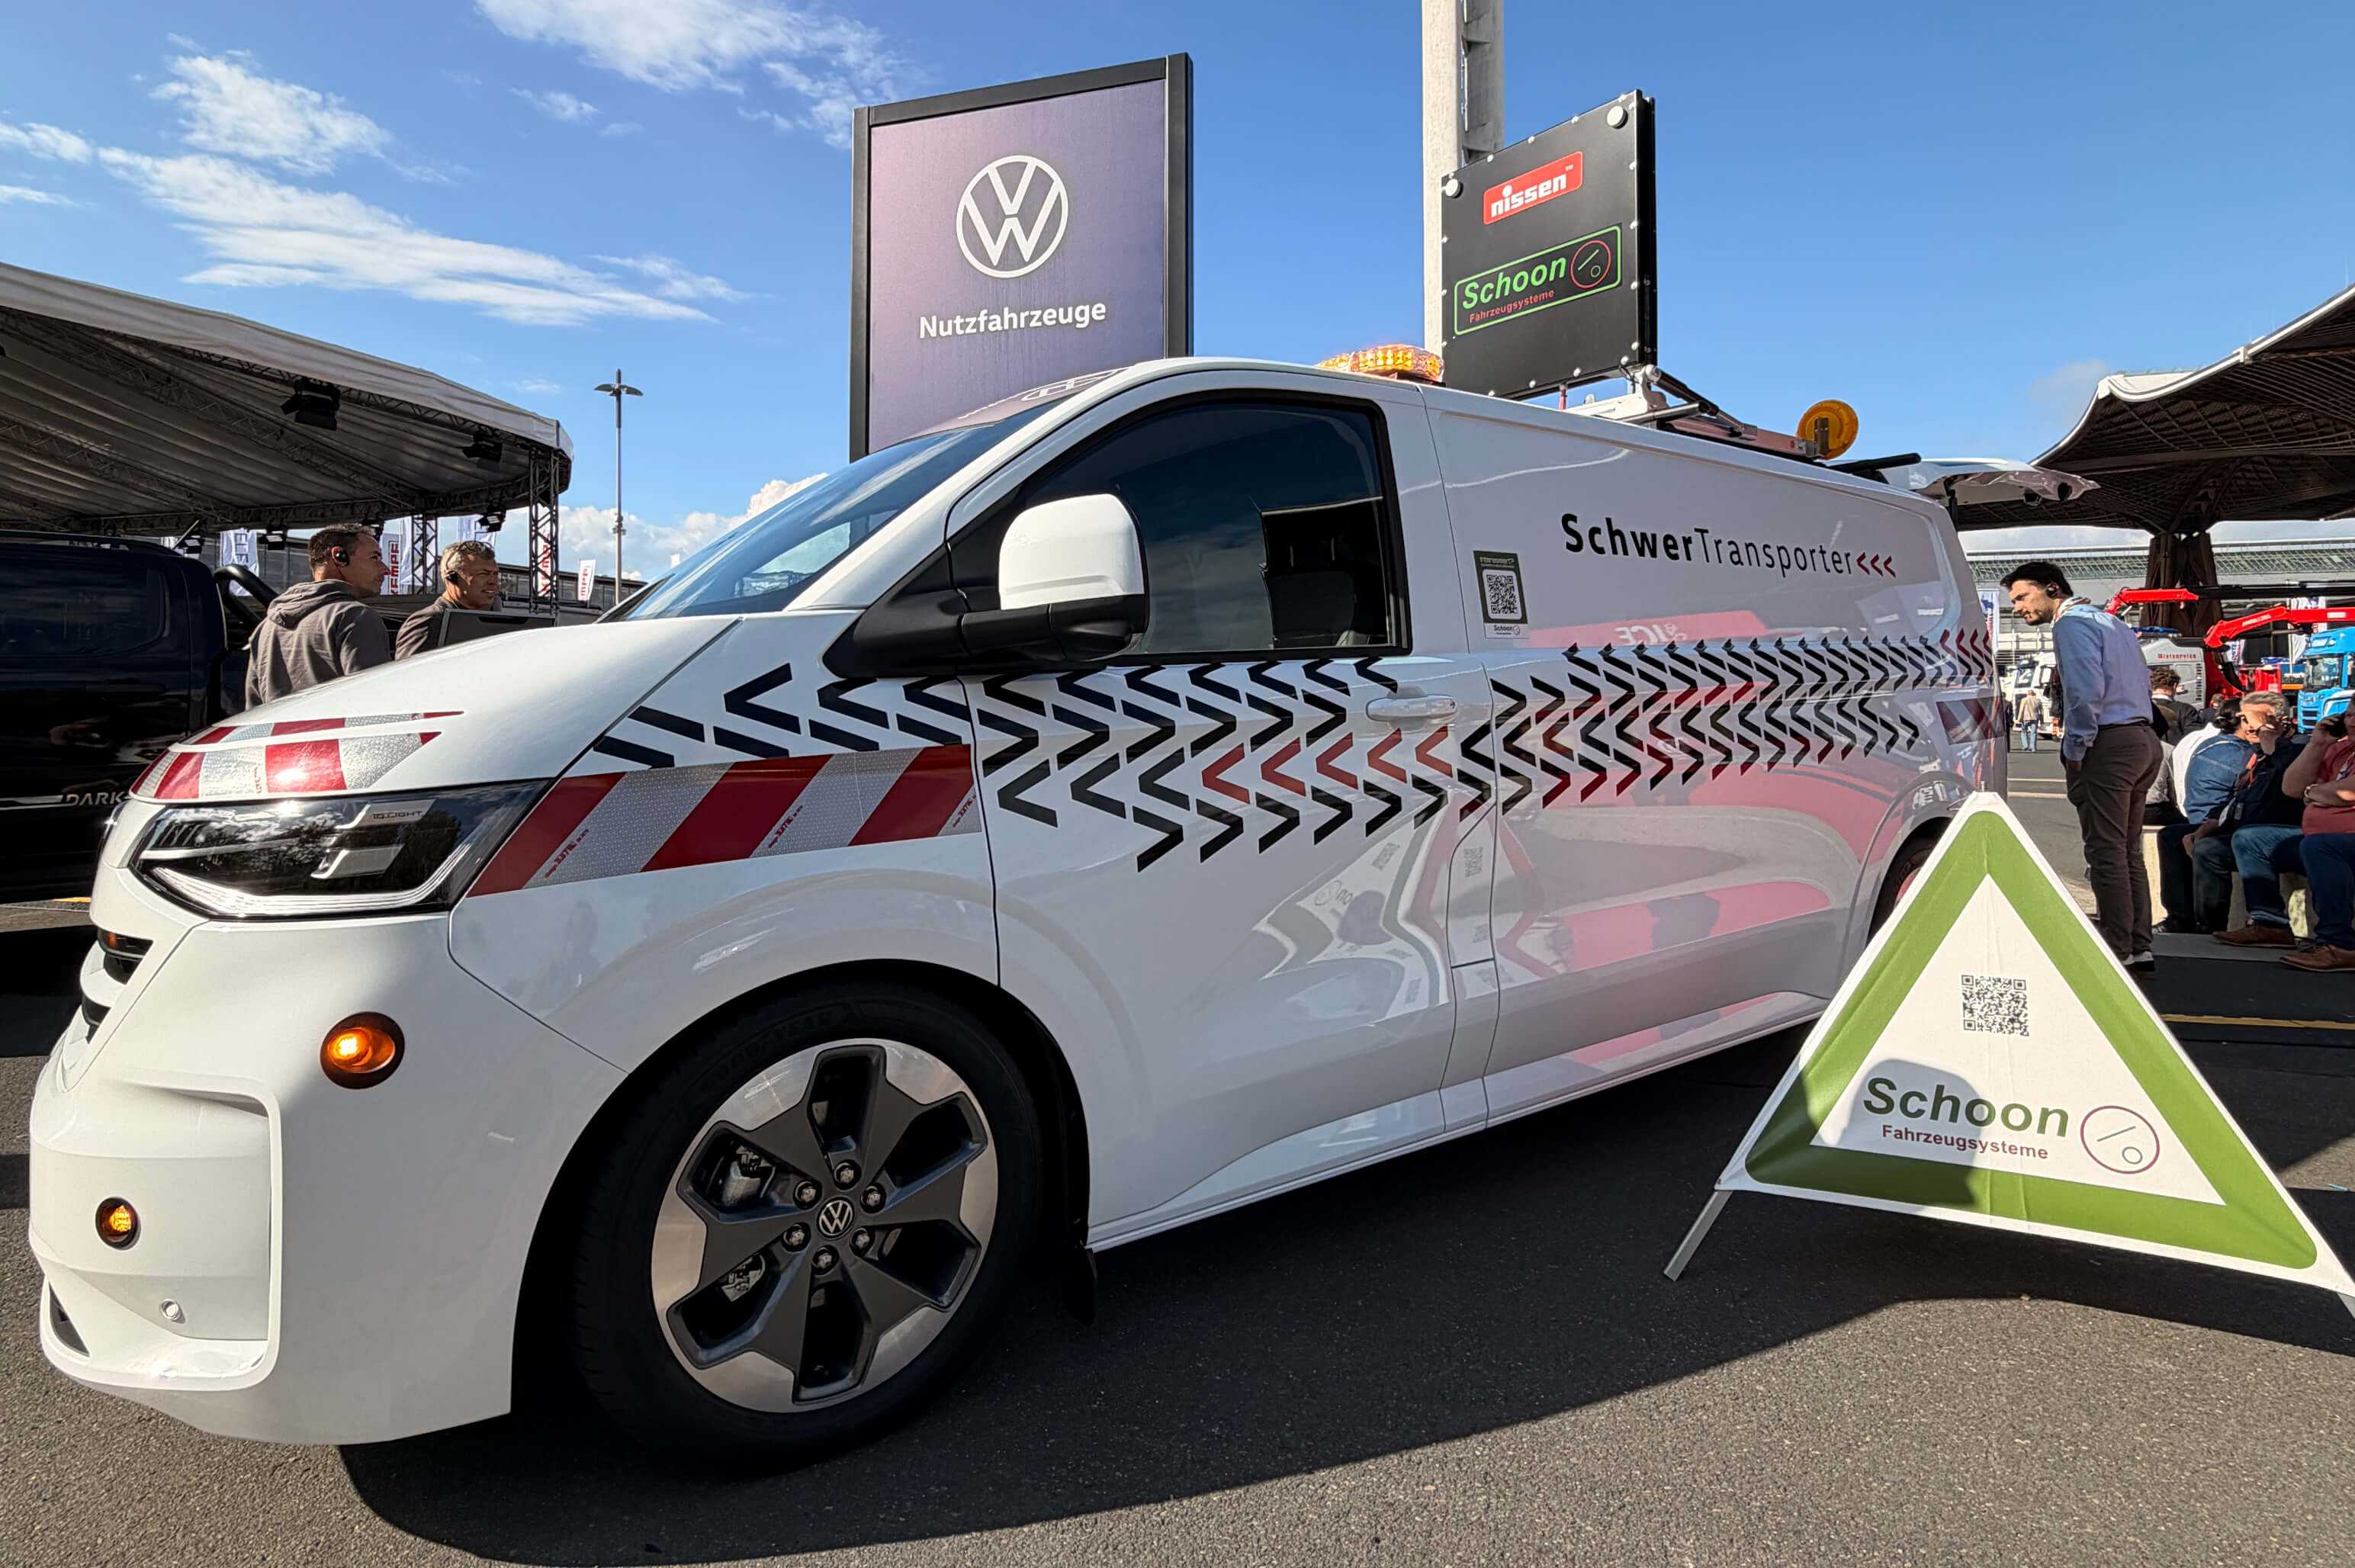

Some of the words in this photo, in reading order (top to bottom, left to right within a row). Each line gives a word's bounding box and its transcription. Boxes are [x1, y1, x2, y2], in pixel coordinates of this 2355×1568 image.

[1491, 173, 1566, 218] nissen
[1462, 257, 1566, 310] Schoon
[919, 302, 1107, 339] Nutzfahrzeuge
[1469, 290, 1555, 323] Fahrzeugsysteme
[66, 792, 124, 806] DARK
[1863, 1077, 2069, 1138] Schoon
[1881, 1124, 2049, 1160] Fahrzeugsysteme
